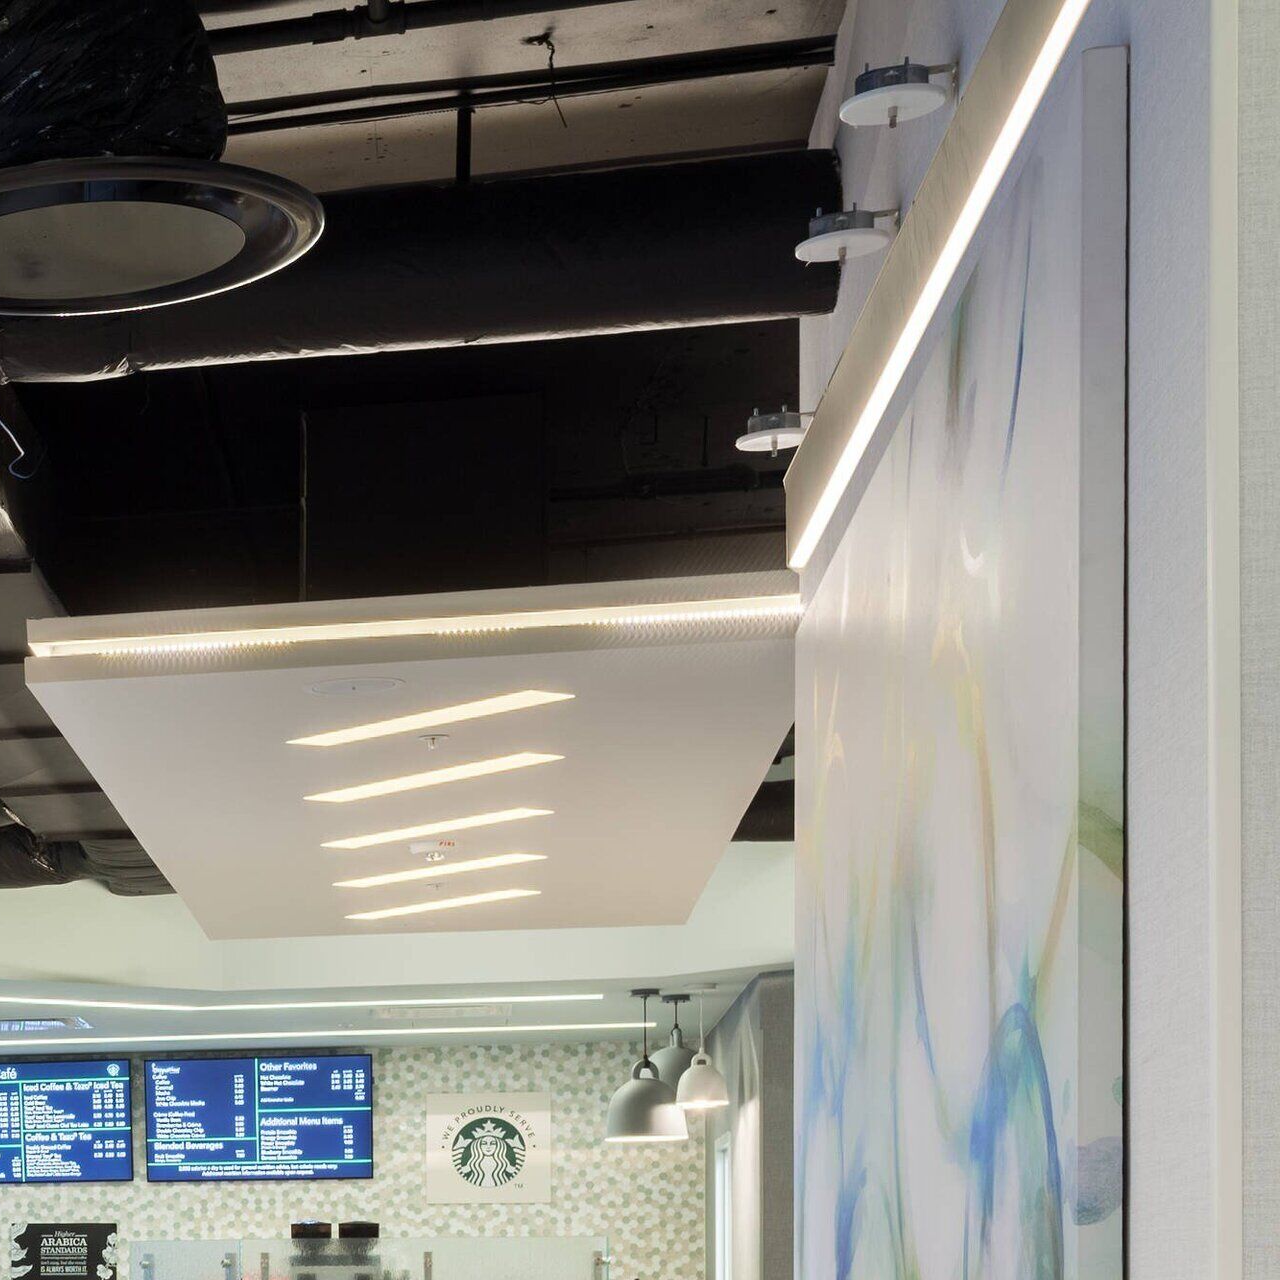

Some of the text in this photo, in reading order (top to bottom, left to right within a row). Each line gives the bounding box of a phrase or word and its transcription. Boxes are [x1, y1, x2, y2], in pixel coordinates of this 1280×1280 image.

[260, 1061, 318, 1072] Other Favorites
[23, 1083, 39, 1092] Iced
[40, 1082, 65, 1091] Coffee
[65, 1082, 73, 1091] &
[93, 1081, 110, 1090] Iced
[110, 1080, 124, 1090] Tea
[260, 1116, 344, 1126] Additional Menu Items
[442, 1105, 536, 1140] WE PROUDLY SERVE
[25, 1133, 50, 1142] Coffee
[50, 1133, 57, 1141] &
[78, 1132, 92, 1141] Tea
[154, 1141, 224, 1152] Blended Beverages
[40, 1238, 88, 1246] ARABICA
